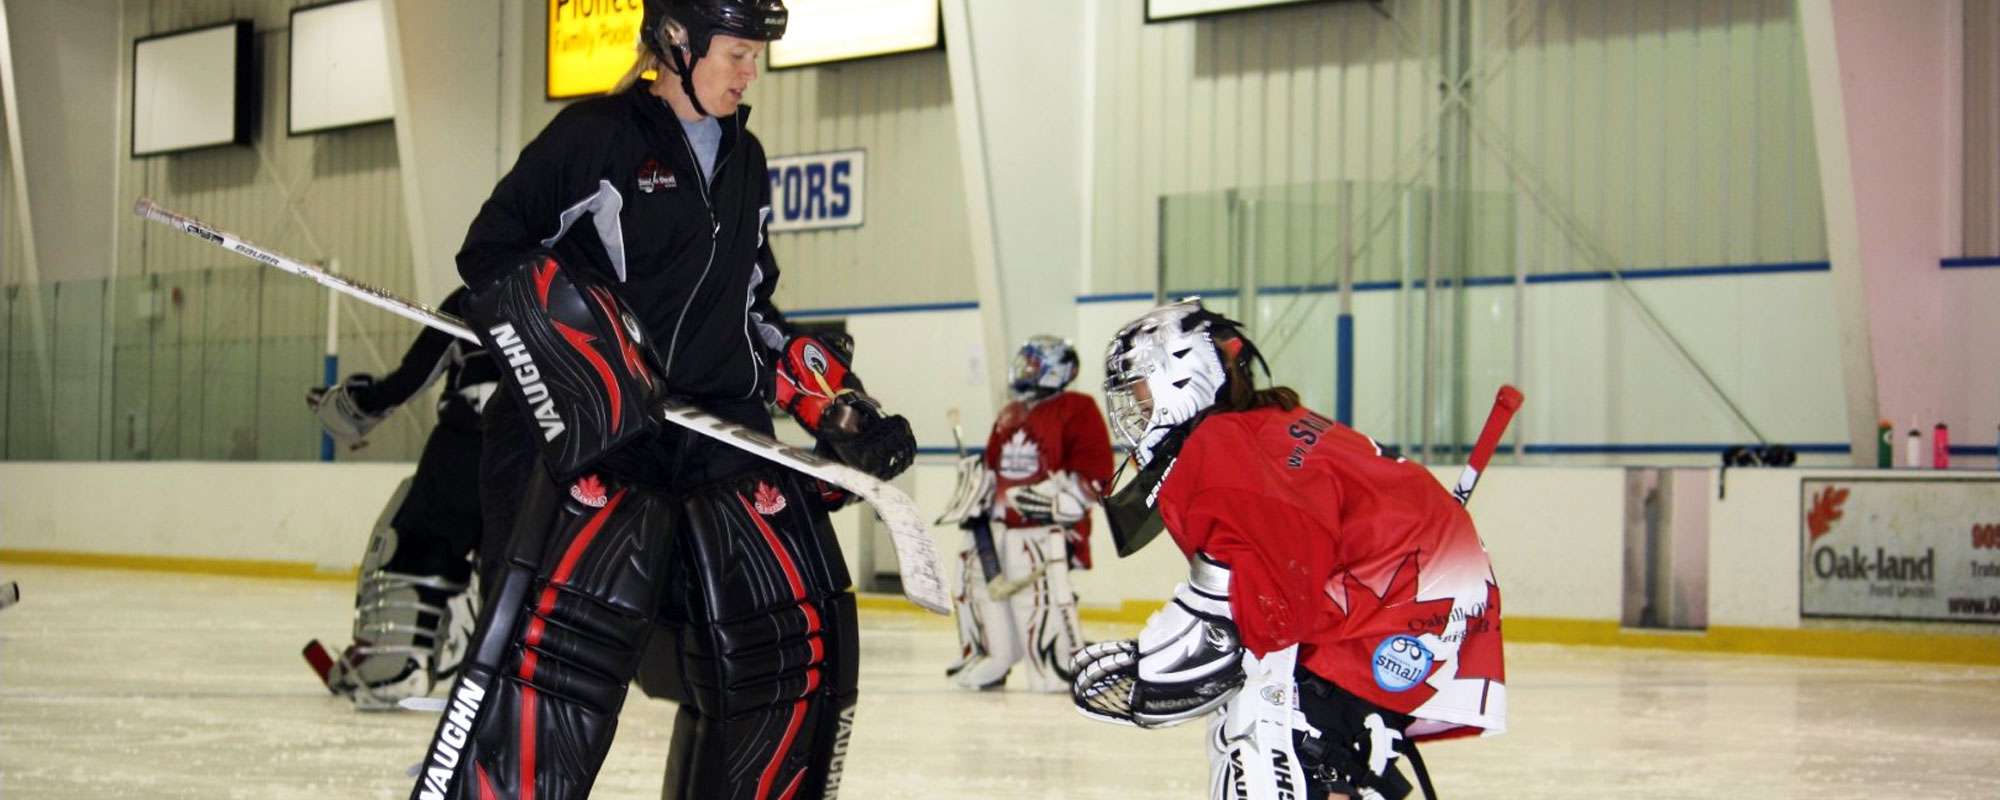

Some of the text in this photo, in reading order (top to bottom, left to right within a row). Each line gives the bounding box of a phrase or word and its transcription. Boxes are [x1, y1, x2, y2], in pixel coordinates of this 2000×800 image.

[489, 321, 566, 443] VAUGHN
[1814, 546, 1934, 580] Oak-land
[1375, 654, 1422, 683] small
[420, 677, 486, 800] VAUGHN
[1230, 749, 1250, 800] VAU
